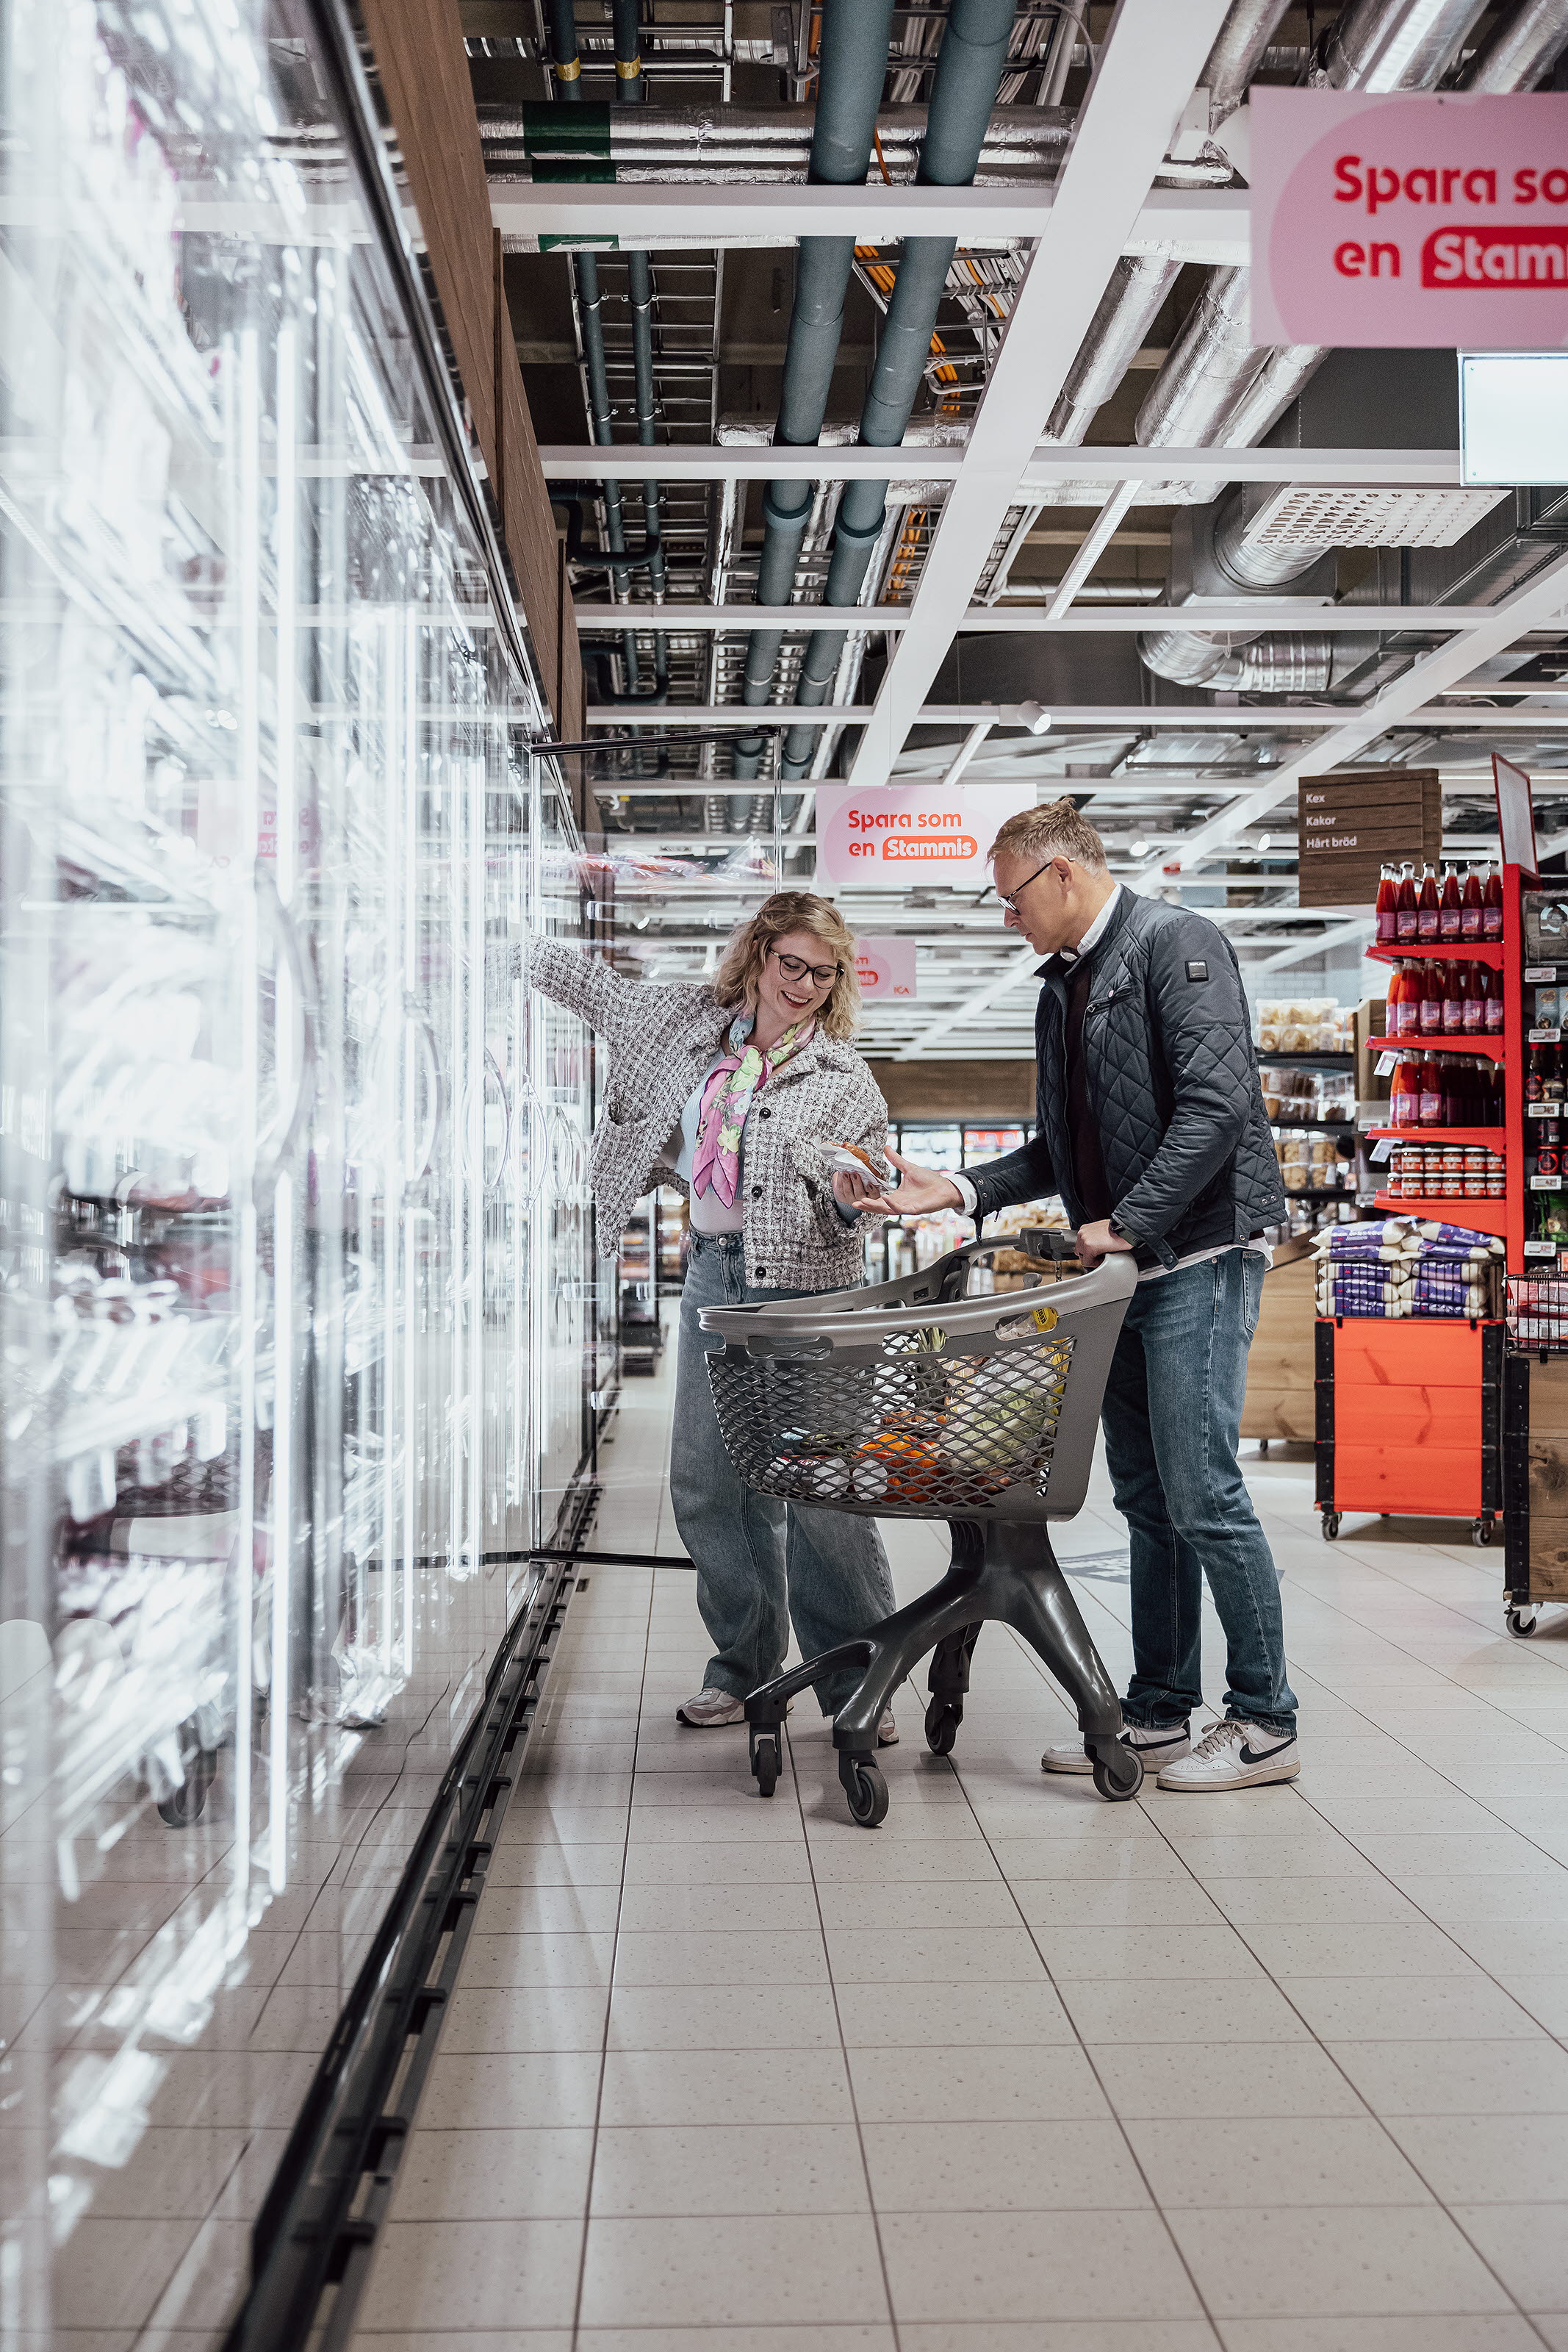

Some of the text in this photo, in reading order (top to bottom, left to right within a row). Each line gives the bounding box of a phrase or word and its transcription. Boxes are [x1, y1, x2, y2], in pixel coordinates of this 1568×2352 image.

[1334, 155, 1497, 215] Spara
[1333, 234, 1568, 281] en Stam
[1306, 794, 1326, 804] Kex
[848, 810, 962, 833] Spara som
[1306, 816, 1337, 826] Kakor
[849, 838, 972, 857] en Stammis
[1306, 836, 1358, 849] Hårt bröd
[893, 986, 910, 994] ICA
